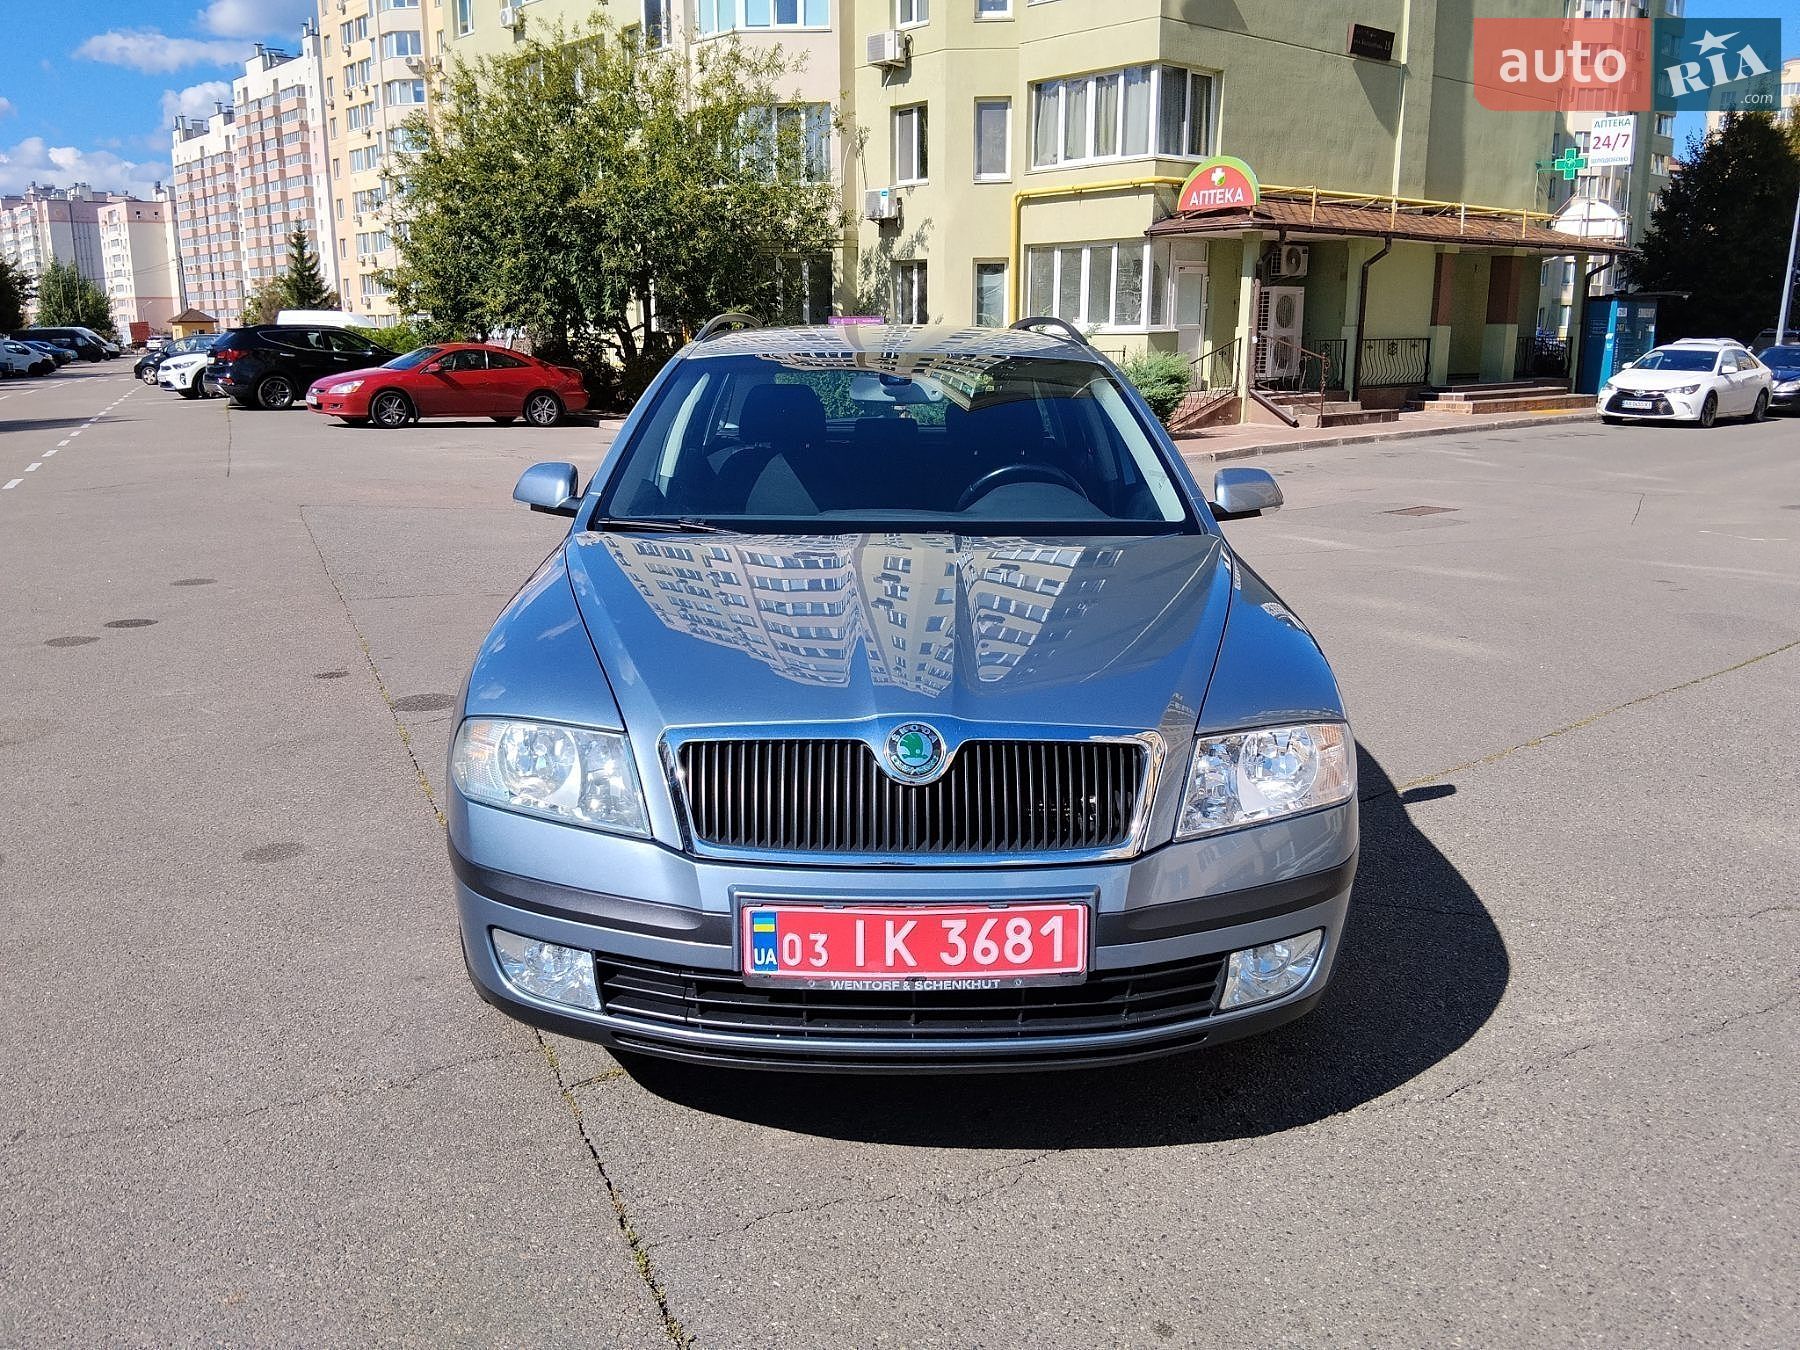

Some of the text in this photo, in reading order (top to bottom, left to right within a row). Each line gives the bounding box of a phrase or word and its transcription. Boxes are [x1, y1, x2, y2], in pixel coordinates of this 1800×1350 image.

[1594, 117, 1631, 128] АПТЕКА
[1592, 133, 1630, 151] 24/7
[1189, 187, 1244, 206] АПТЕКА
[782, 915, 1063, 967] 03 IK 3681
[754, 947, 777, 965] UA
[830, 979, 1001, 990] WENTORF & SCHENKHUT
